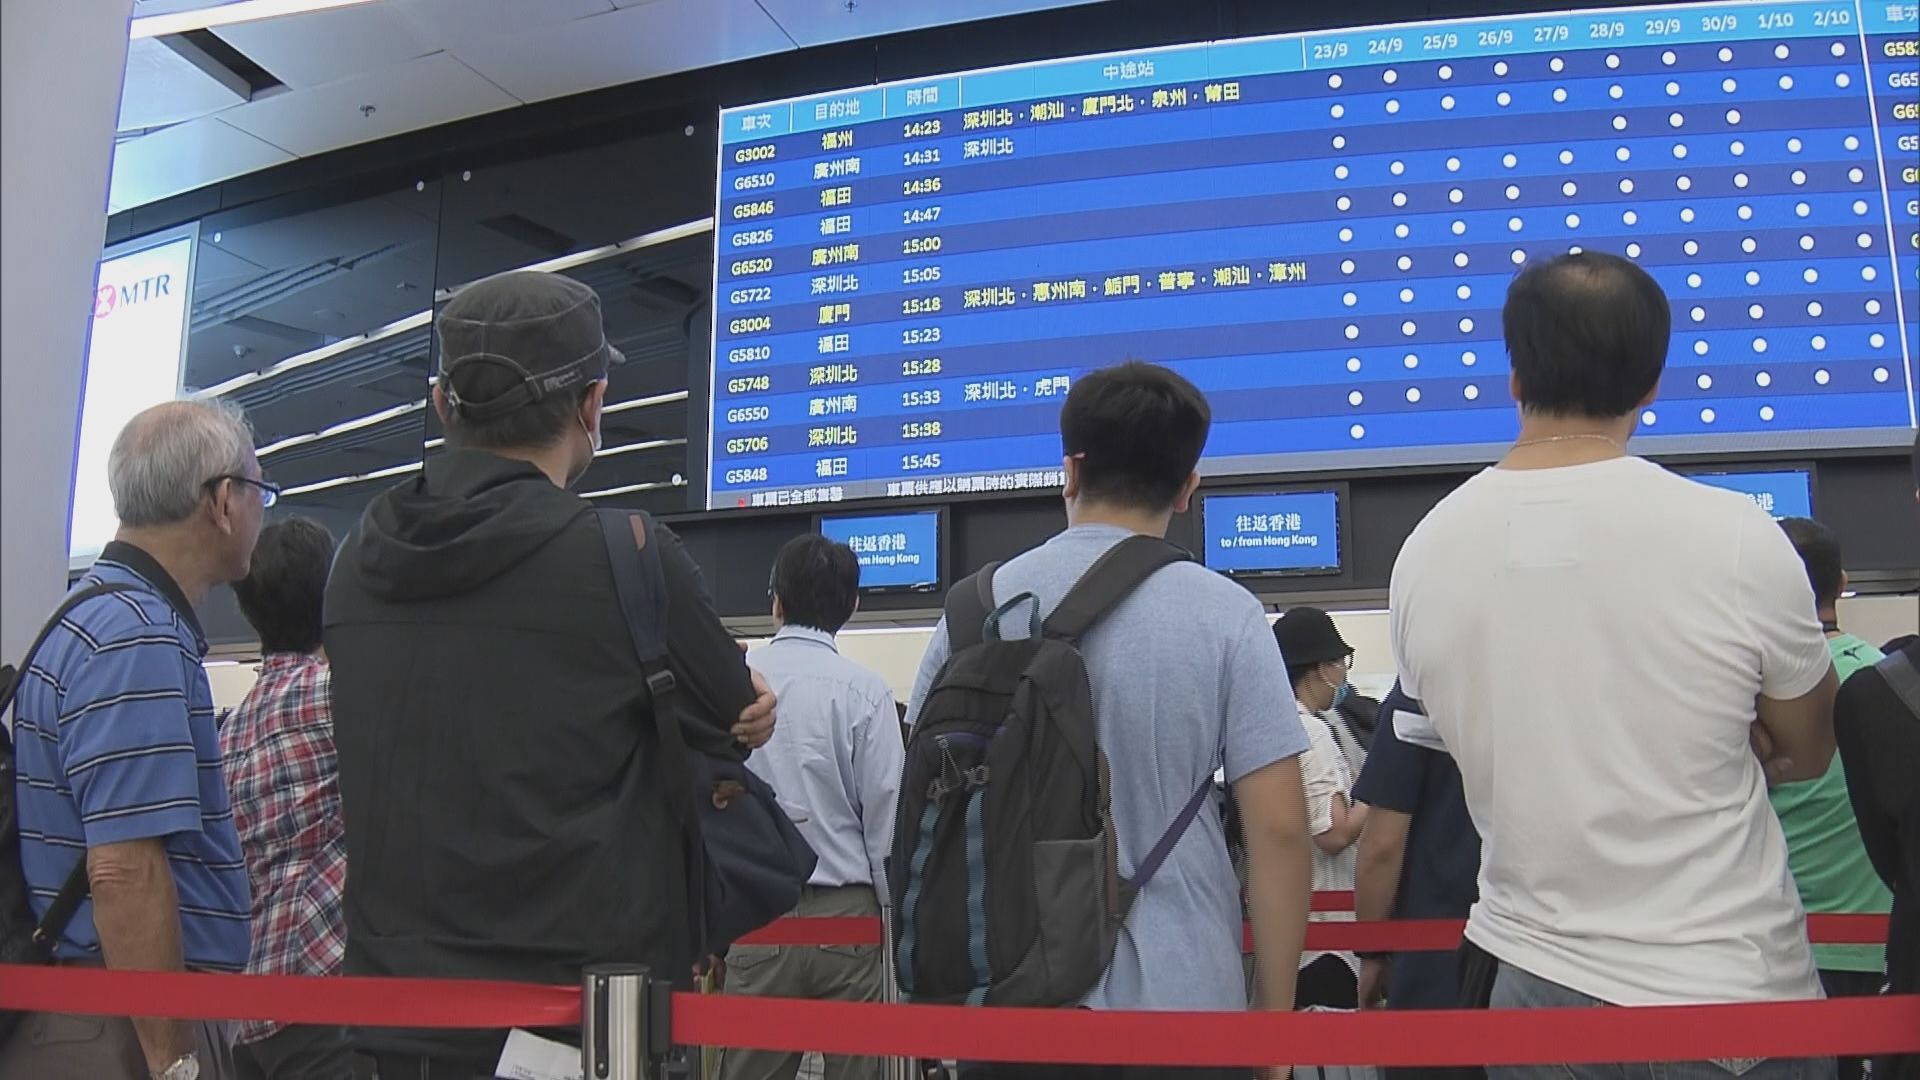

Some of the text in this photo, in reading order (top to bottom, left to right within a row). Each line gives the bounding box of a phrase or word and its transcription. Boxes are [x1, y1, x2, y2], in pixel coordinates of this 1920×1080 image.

[739, 9, 1850, 132] 車次 目的地 時間 中途站 23/9 24/9 25/9 26/9 27/9 28/9 29/9 30/9 1/10 2/10
[736, 144, 776, 163] G3002
[821, 130, 853, 150] 福州
[904, 120, 941, 138] 14:23
[734, 137, 1014, 190] G6510 廣州南 14:31 深圳北
[733, 177, 941, 219] G5846 福田 14:36
[732, 206, 941, 246] G5826 福田 14:47
[731, 236, 941, 276] G6520 廣州南 15:00
[119, 273, 171, 309] MTR
[730, 266, 941, 304] G5722 深圳北 15:05
[729, 316, 771, 334] G3004
[818, 303, 850, 324] 廈門
[903, 296, 941, 314] 15:18
[729, 327, 941, 363] G5810 福田 15:23
[728, 358, 941, 393] G5748 深圳北 15:28
[727, 406, 769, 423] G6550
[809, 394, 857, 416] 廣州南
[902, 390, 941, 406] 15:33
[726, 421, 941, 453] G5706 深圳北 15:38
[726, 453, 941, 484] G5848 福田 15:45
[1220, 536, 1232, 548] to
[1238, 535, 1262, 547] from
[1263, 534, 1291, 548] Hong
[1291, 533, 1318, 547] Kong
[1235, 512, 1301, 533] 往返香港
[849, 533, 907, 553] 往返香港
[871, 554, 896, 567] Hong
[896, 552, 920, 566] Kong
